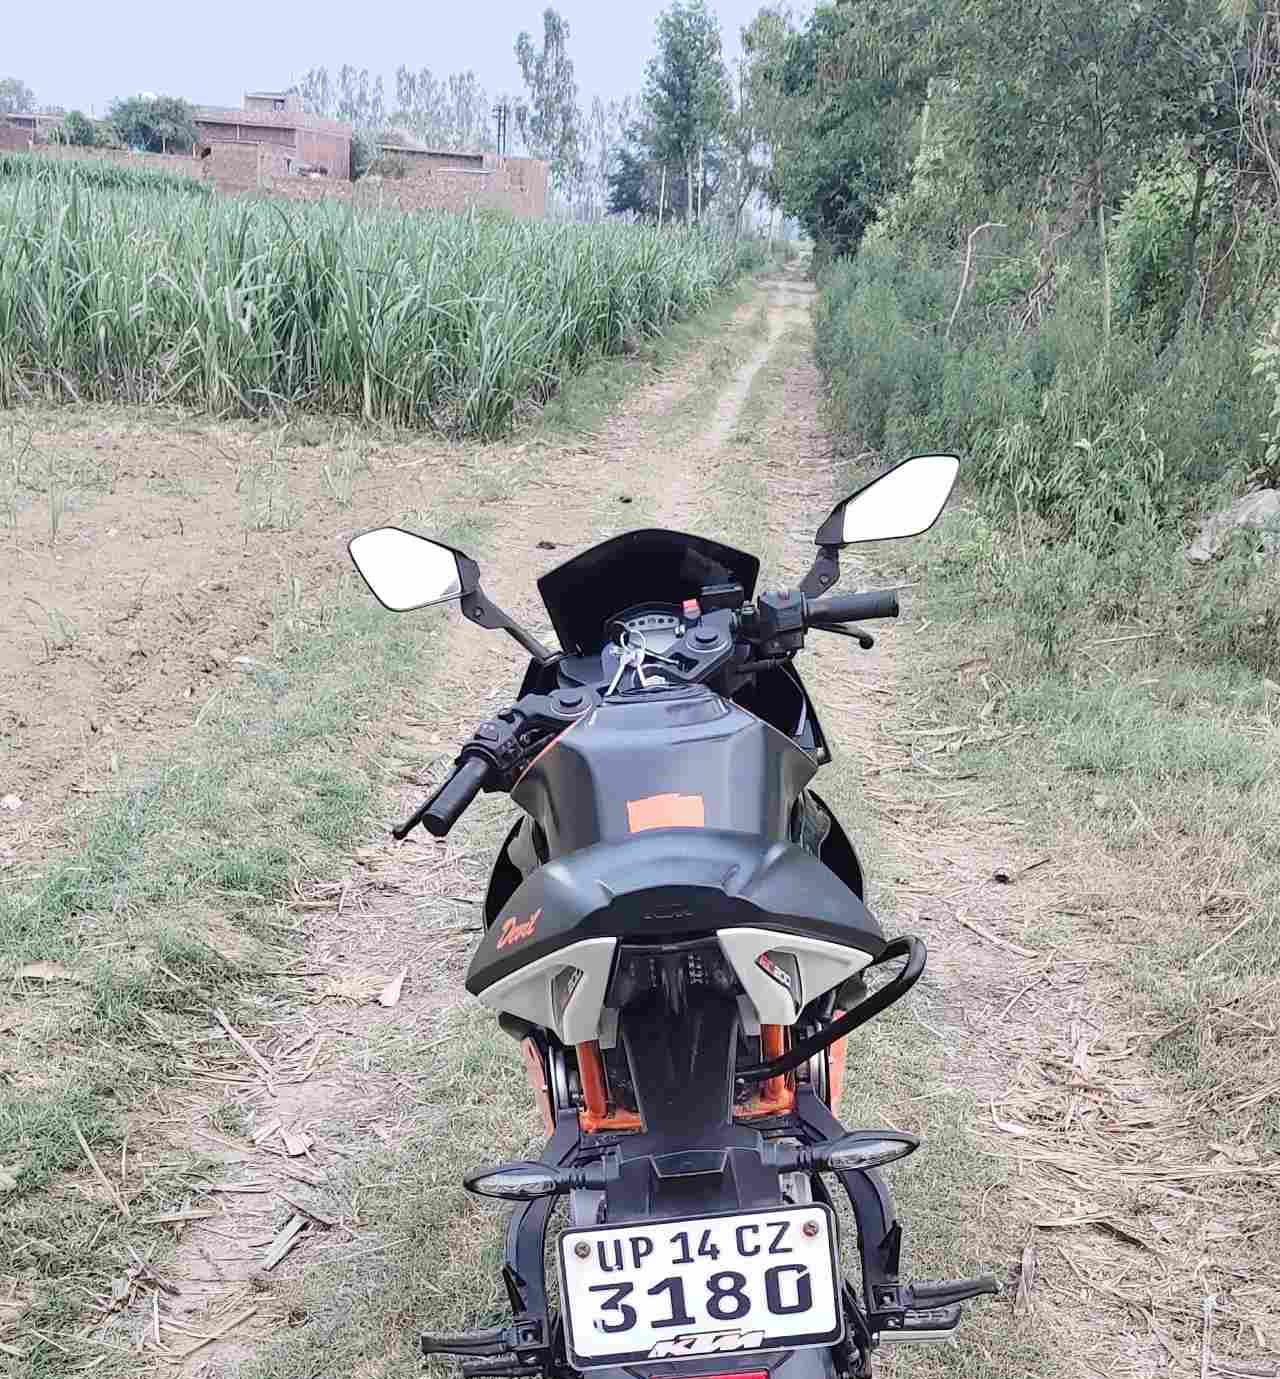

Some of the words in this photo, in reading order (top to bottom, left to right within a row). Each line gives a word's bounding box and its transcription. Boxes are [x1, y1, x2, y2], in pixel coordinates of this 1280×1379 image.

[597, 1239, 654, 1272] UP
[669, 1229, 720, 1264] 14
[735, 1221, 793, 1256] CZ
[588, 1264, 813, 1333] 3180
